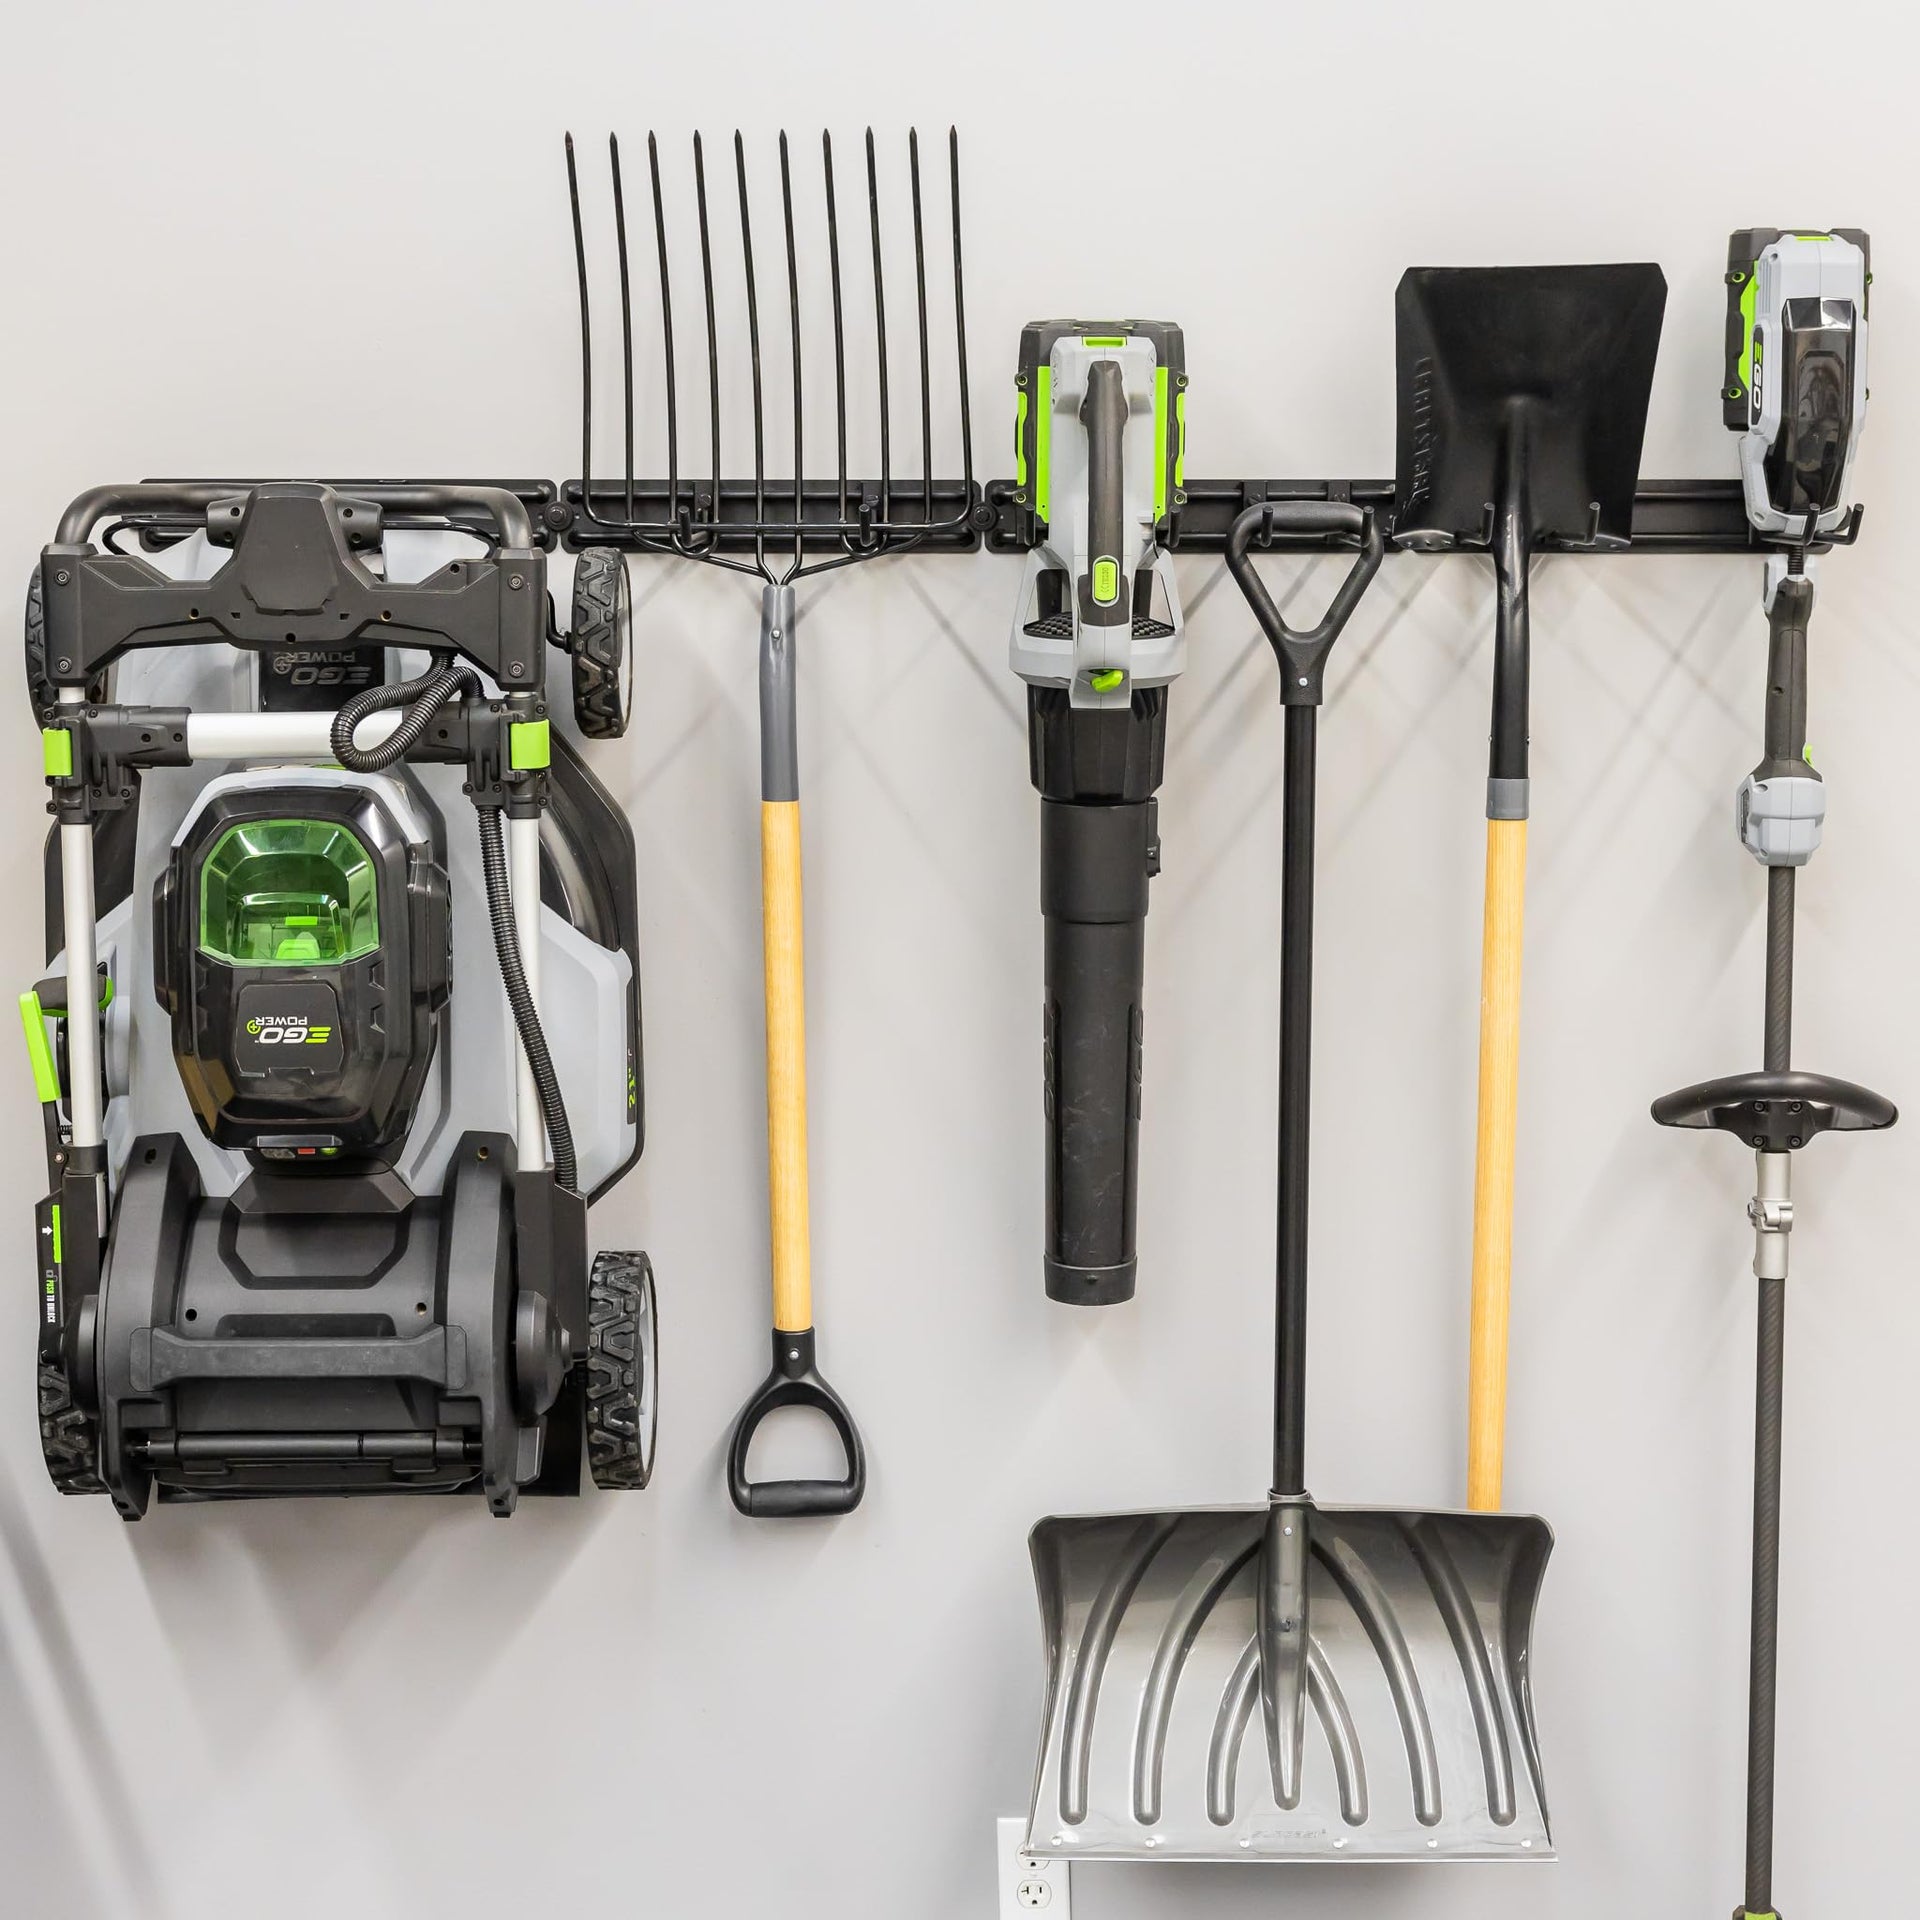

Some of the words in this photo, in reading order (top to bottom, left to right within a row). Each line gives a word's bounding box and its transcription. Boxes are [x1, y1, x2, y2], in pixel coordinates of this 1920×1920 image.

[1753, 341, 1763, 410] EGO
[286, 651, 356, 663] POWER
[291, 666, 371, 685] EGO
[255, 1016, 308, 1026] POWER
[258, 1026, 331, 1044] EGO
[46, 1279, 55, 1294] PUSH
[47, 1302, 56, 1323] UNLOCK
